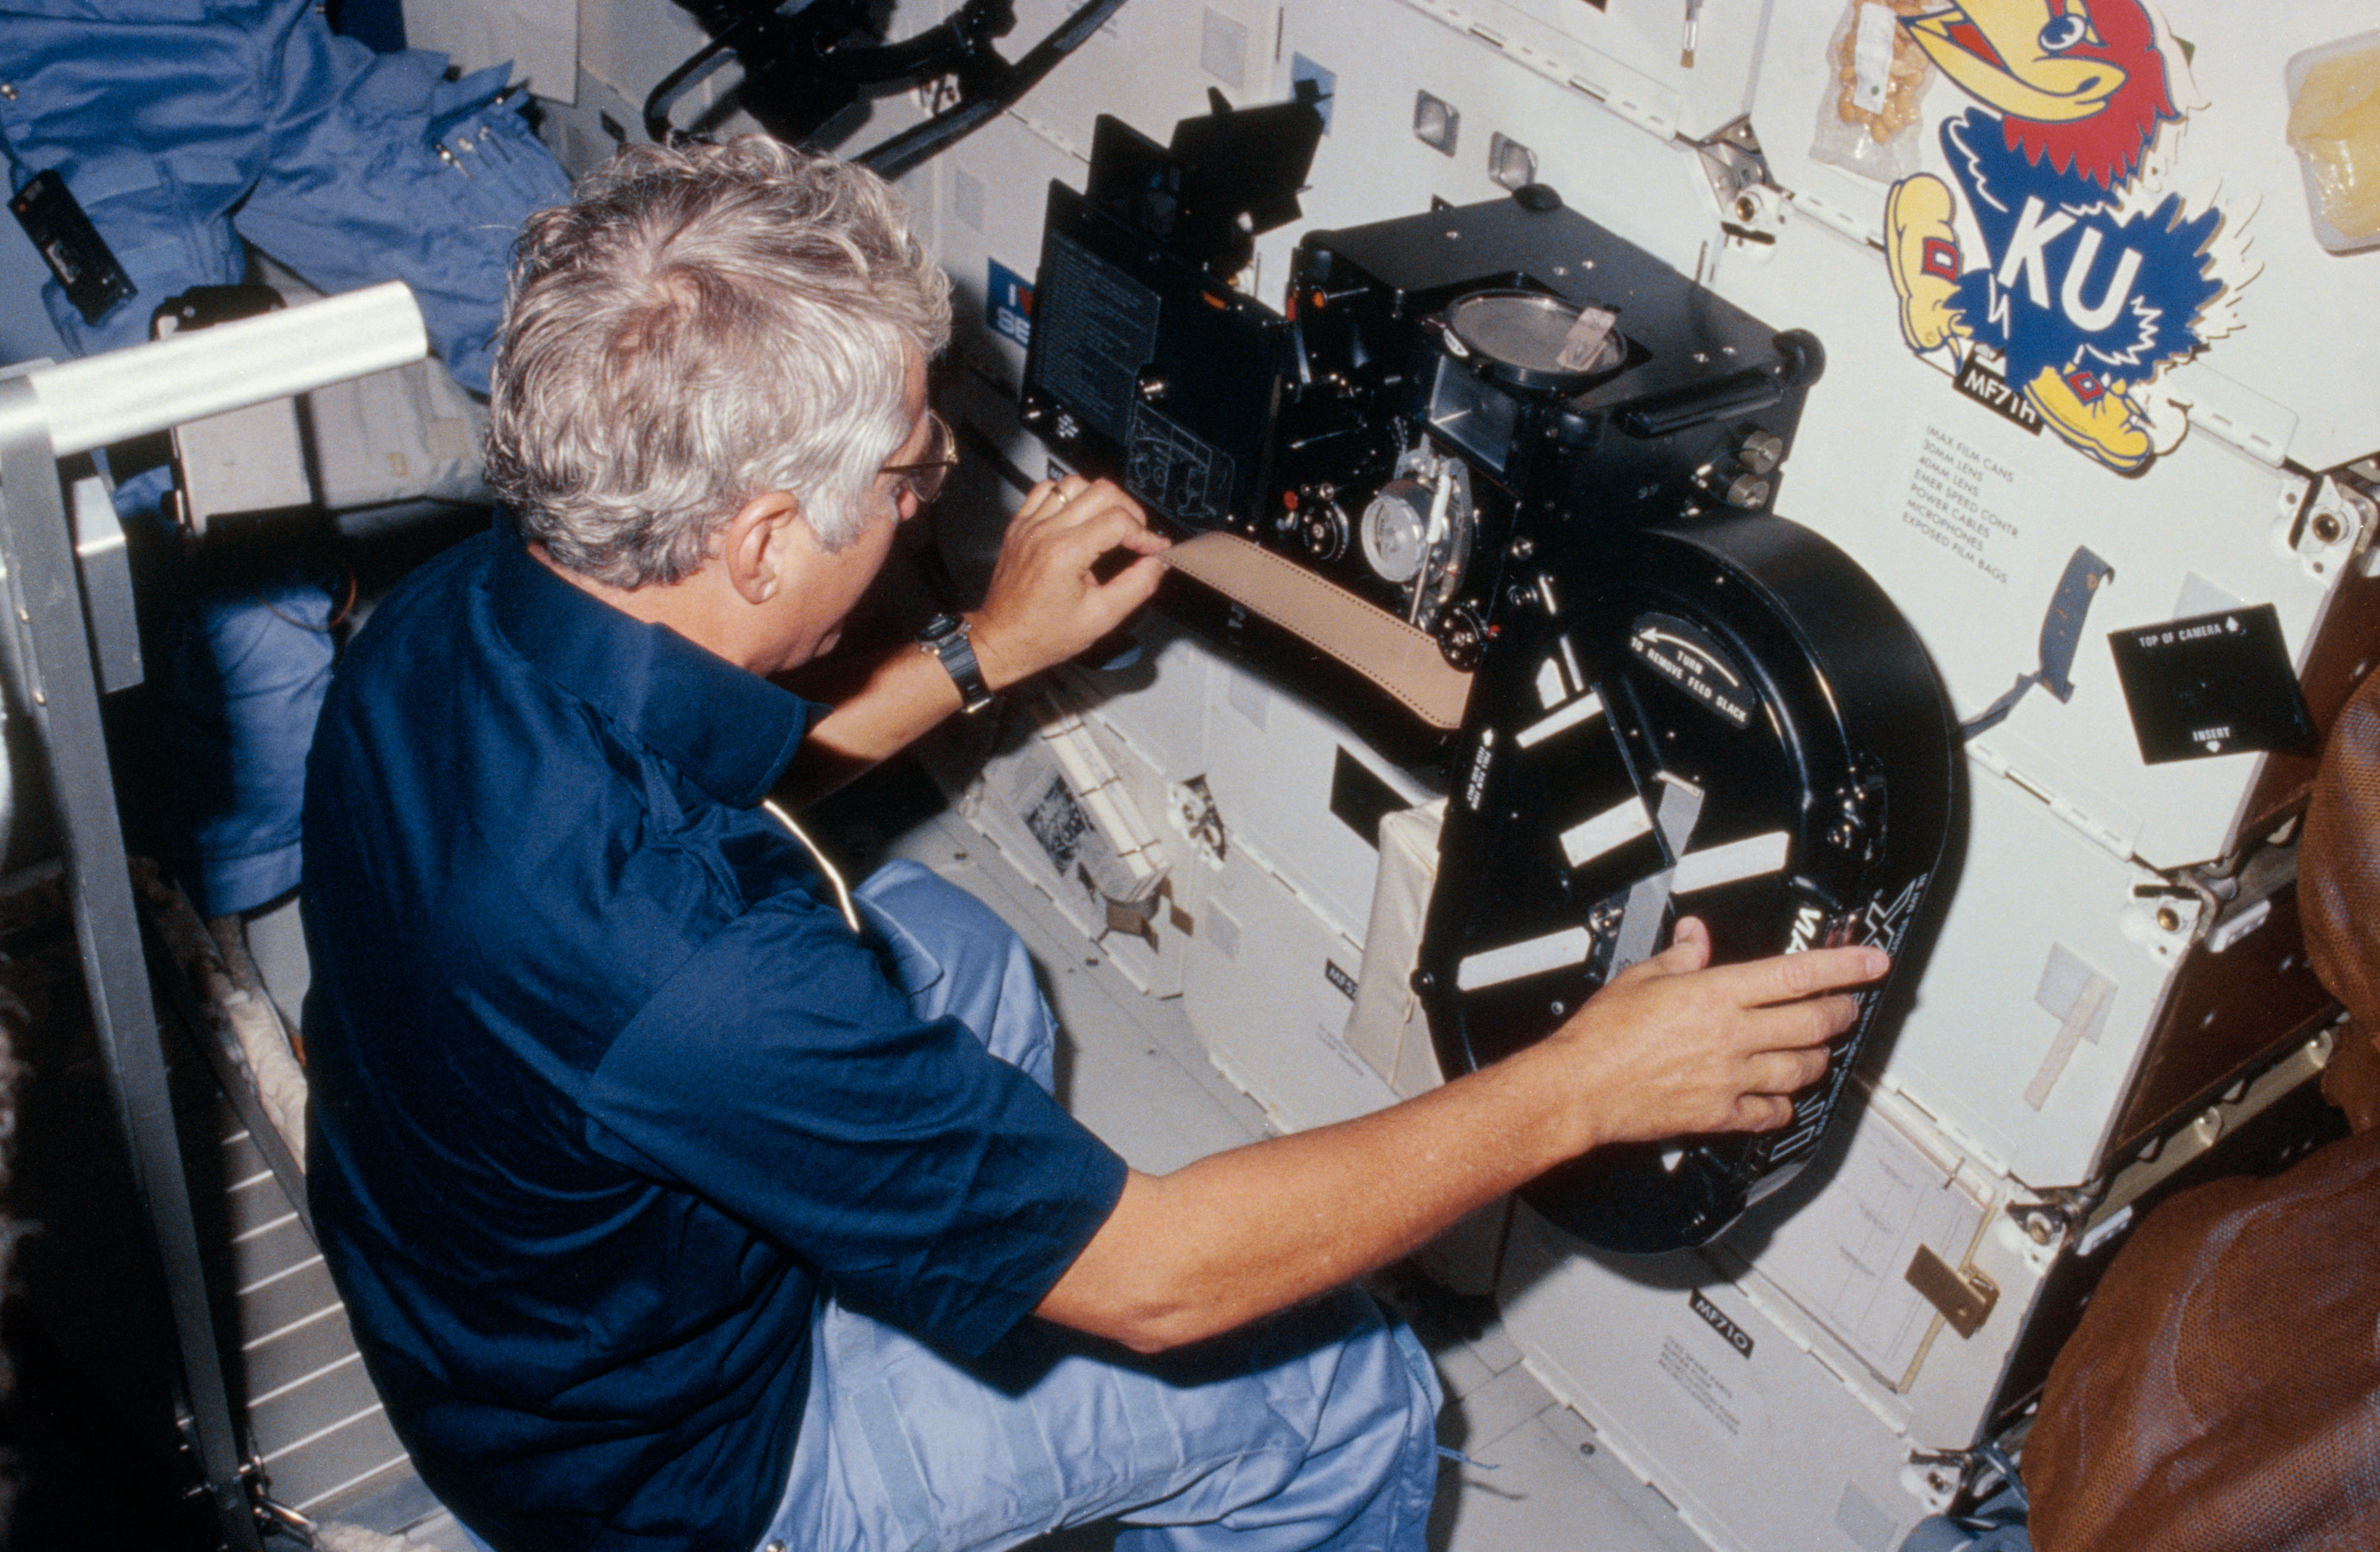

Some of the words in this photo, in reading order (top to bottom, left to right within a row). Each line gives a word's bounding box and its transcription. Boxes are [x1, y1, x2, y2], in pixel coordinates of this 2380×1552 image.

[1997, 195, 2143, 332] KU
[998, 307, 1031, 345] SE
[1919, 456, 1949, 480] 40MM
[1953, 475, 1978, 497] LENS
[1923, 439, 1954, 464] 30MM
[1957, 460, 1982, 482] LENS
[1957, 442, 1979, 463] FILM
[1983, 458, 2013, 483] CANS
[1911, 483, 1948, 511] POWER
[1952, 509, 1989, 538] CABLES
[1914, 469, 1942, 491] EMER
[1946, 488, 1977, 512] SPEED
[1981, 509, 2018, 537] CONTR
[1907, 499, 1983, 551] MICROPHONES
[1902, 511, 1949, 546] EXPOSED
[1952, 543, 1974, 562] FILM
[1978, 559, 2006, 583] BAGS
[2138, 635, 2158, 648] TOP
[2162, 632, 2174, 644] OF
[2178, 623, 2222, 642] CAMERA
[1631, 636, 1644, 652] TO
[1647, 648, 1683, 679] REMOVE
[1688, 676, 1713, 698] FEED
[1716, 695, 1747, 722] SLACK
[1677, 650, 1703, 674] TURN
[2193, 726, 2230, 742] INSERT
